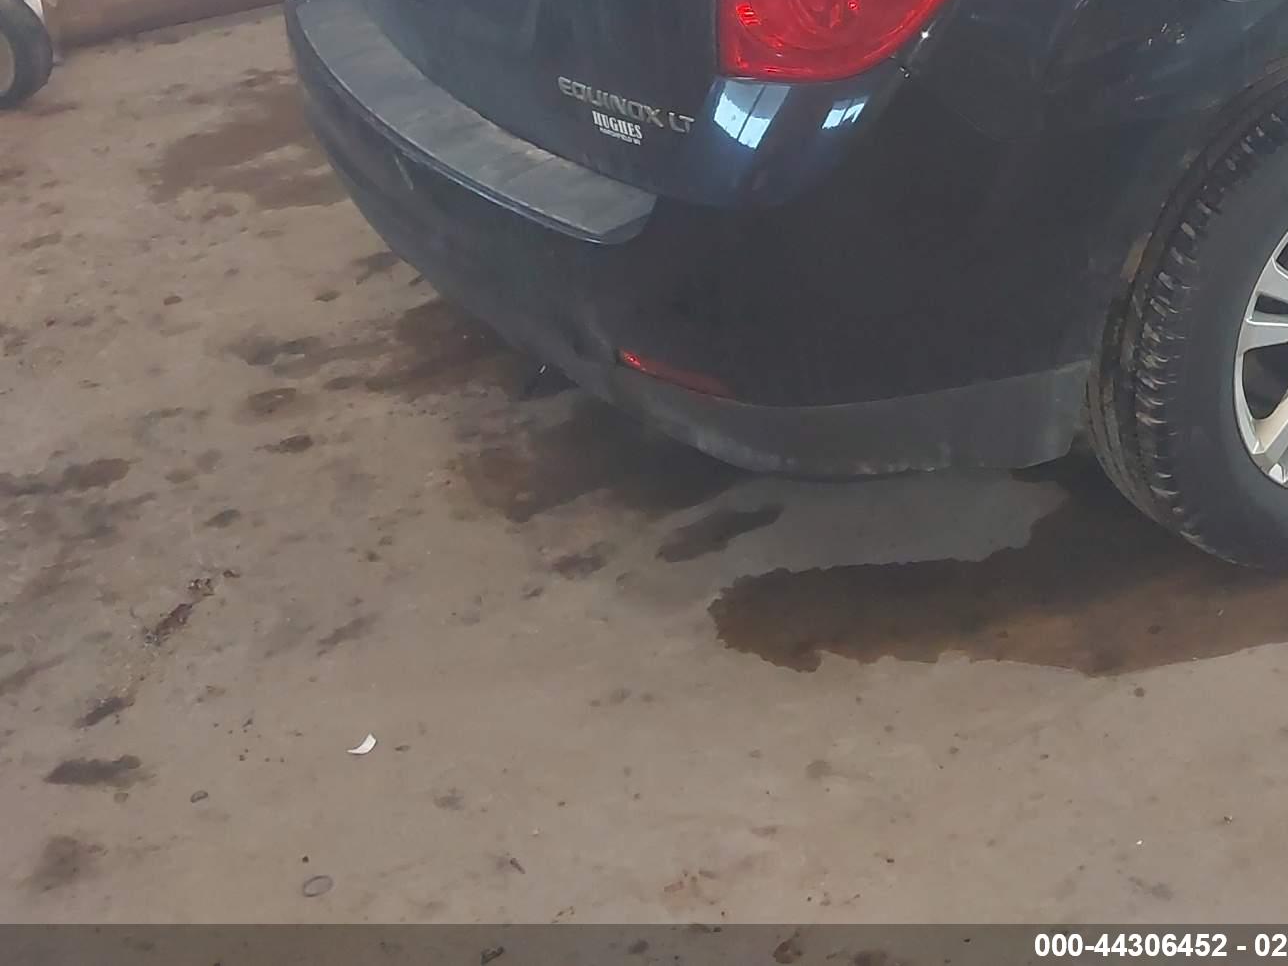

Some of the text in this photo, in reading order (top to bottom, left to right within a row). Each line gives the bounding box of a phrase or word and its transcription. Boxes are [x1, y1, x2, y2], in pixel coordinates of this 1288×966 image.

[558, 75, 695, 133] EQUINOX LT
[591, 110, 643, 139] HUGHES
